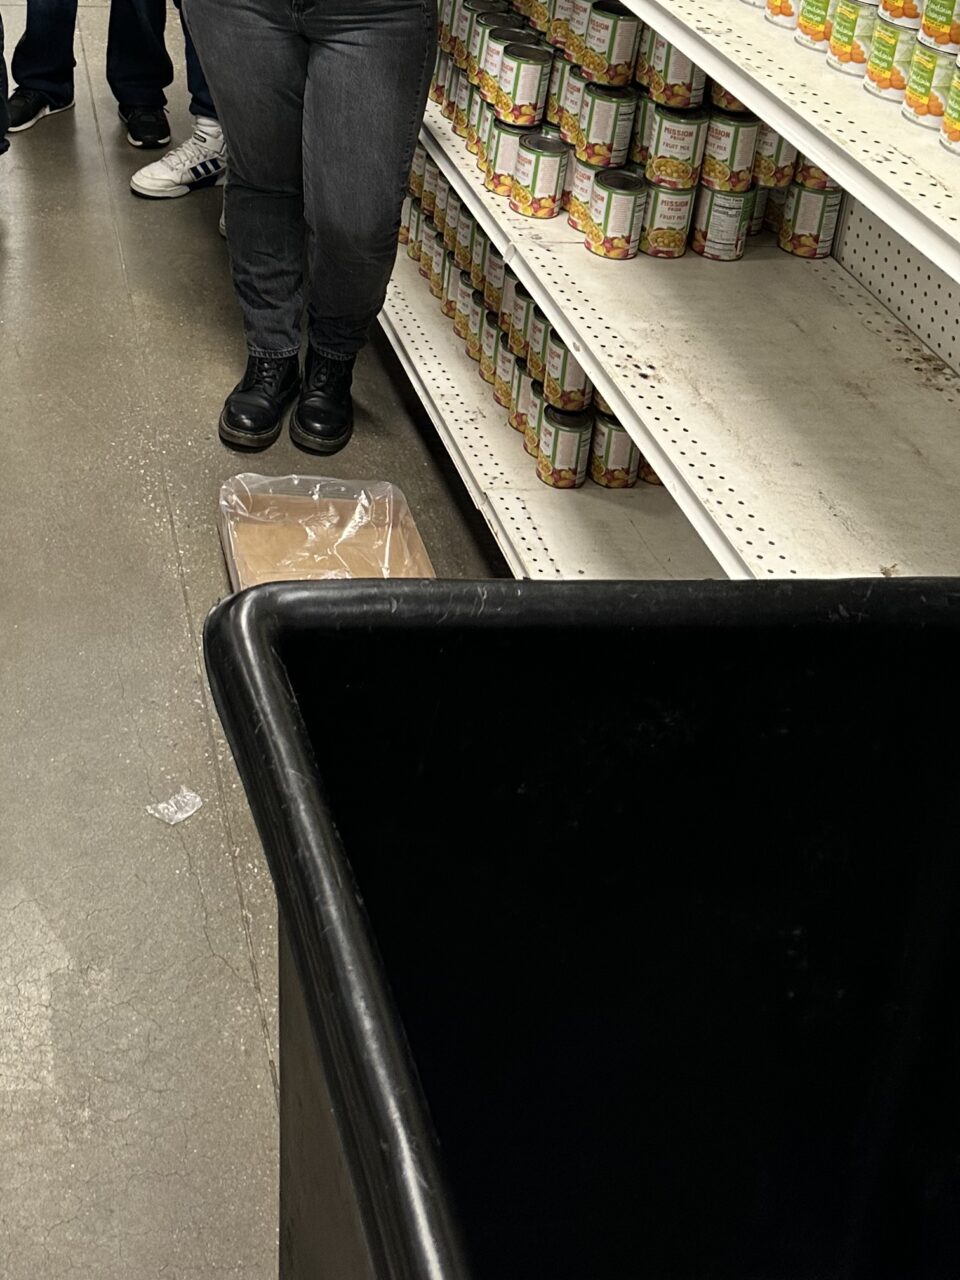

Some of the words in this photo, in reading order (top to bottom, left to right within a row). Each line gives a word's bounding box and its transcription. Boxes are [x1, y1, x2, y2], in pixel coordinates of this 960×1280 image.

[664, 126, 694, 138] MISSION
[662, 141, 678, 150] FRUIT
[661, 200, 689, 208] MISSION
